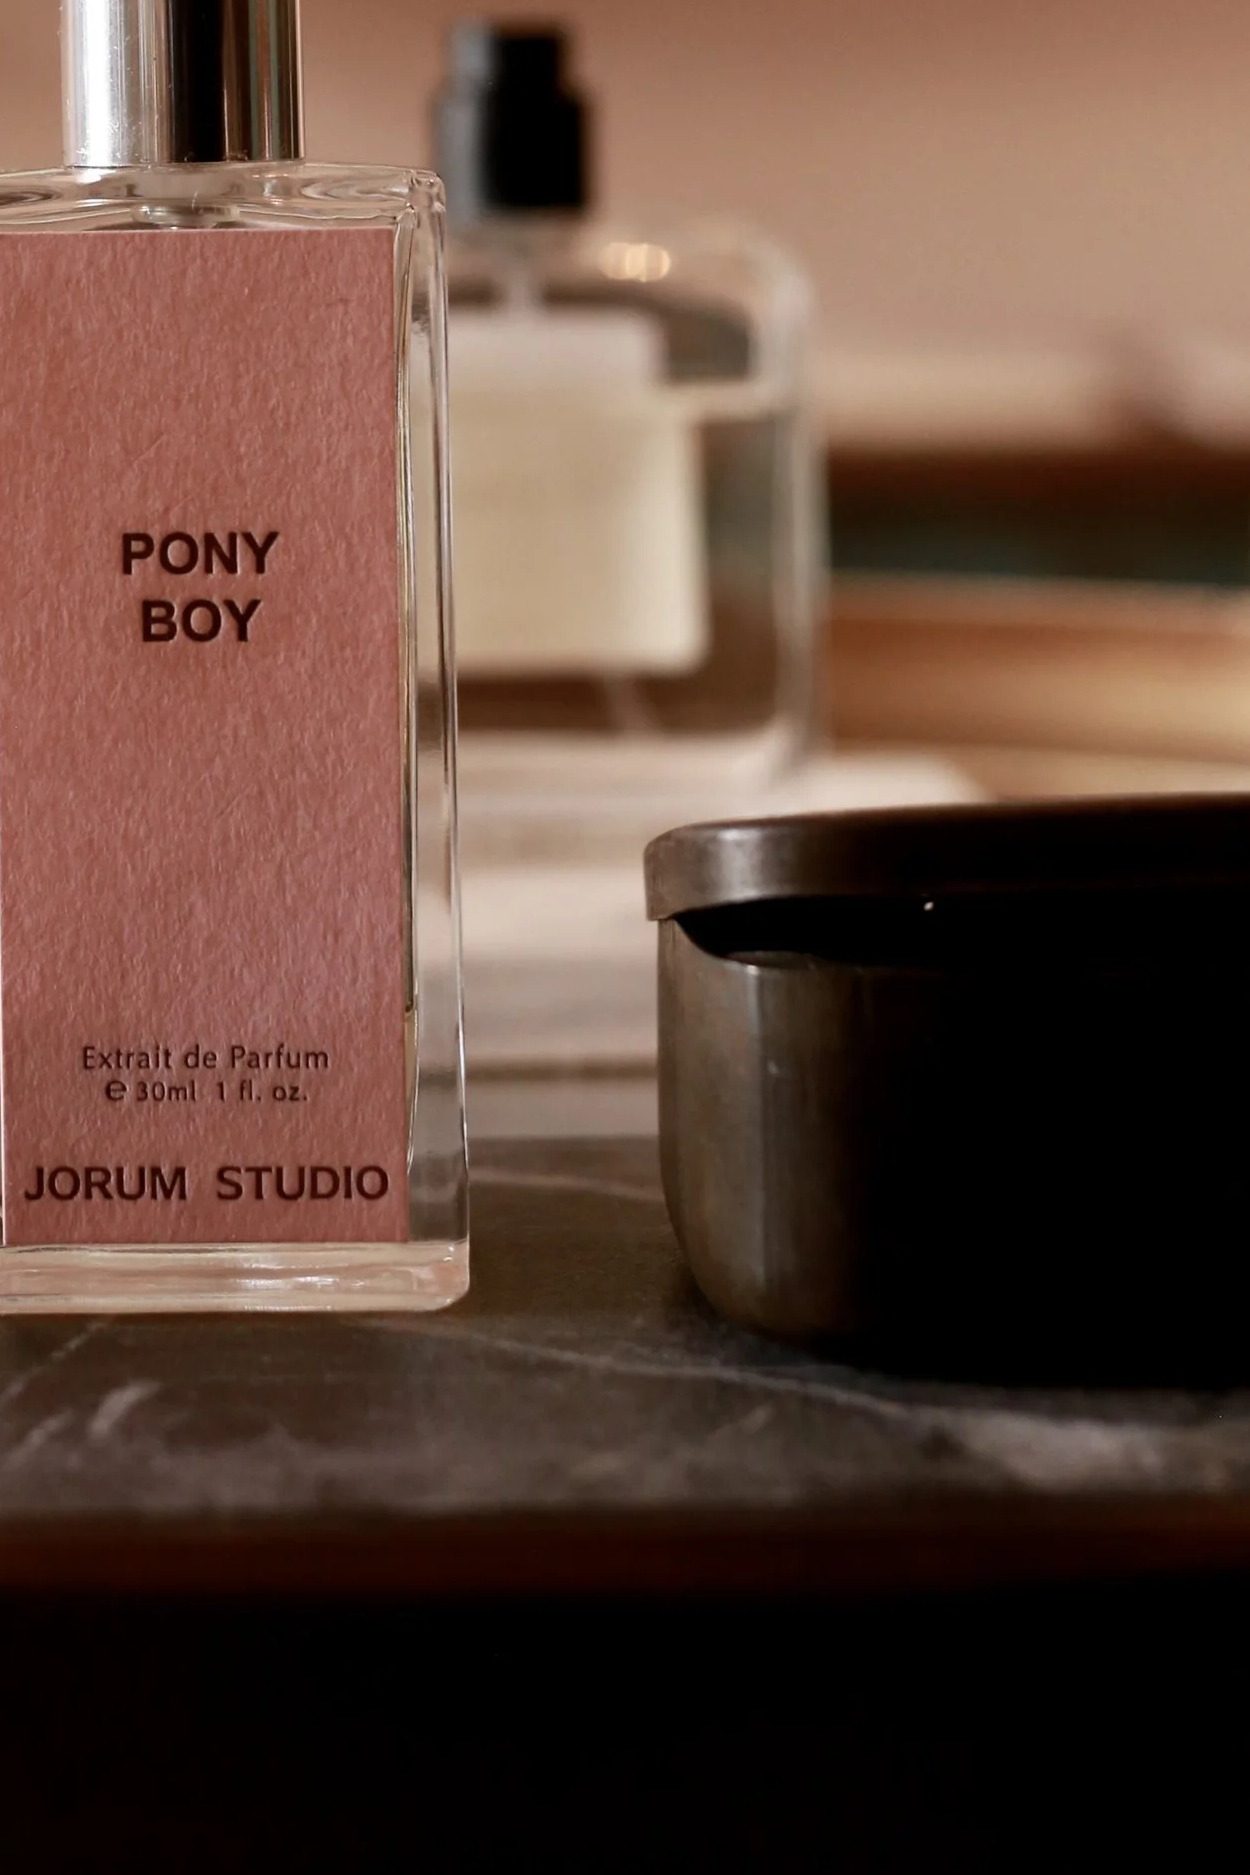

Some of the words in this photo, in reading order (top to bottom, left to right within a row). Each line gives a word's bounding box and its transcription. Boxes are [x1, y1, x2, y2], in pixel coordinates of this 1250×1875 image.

[121, 531, 279, 575] PONY
[141, 599, 261, 643] BOY
[82, 1045, 173, 1070] Extrait
[184, 1044, 217, 1069] de
[230, 1043, 330, 1069] Parfum
[136, 1080, 197, 1102] 30ml
[217, 1081, 226, 1101] 1
[239, 1079, 262, 1102] fl.
[272, 1085, 309, 1102] oz.
[24, 1166, 187, 1201] JORUM
[216, 1165, 390, 1200] STUDIO
